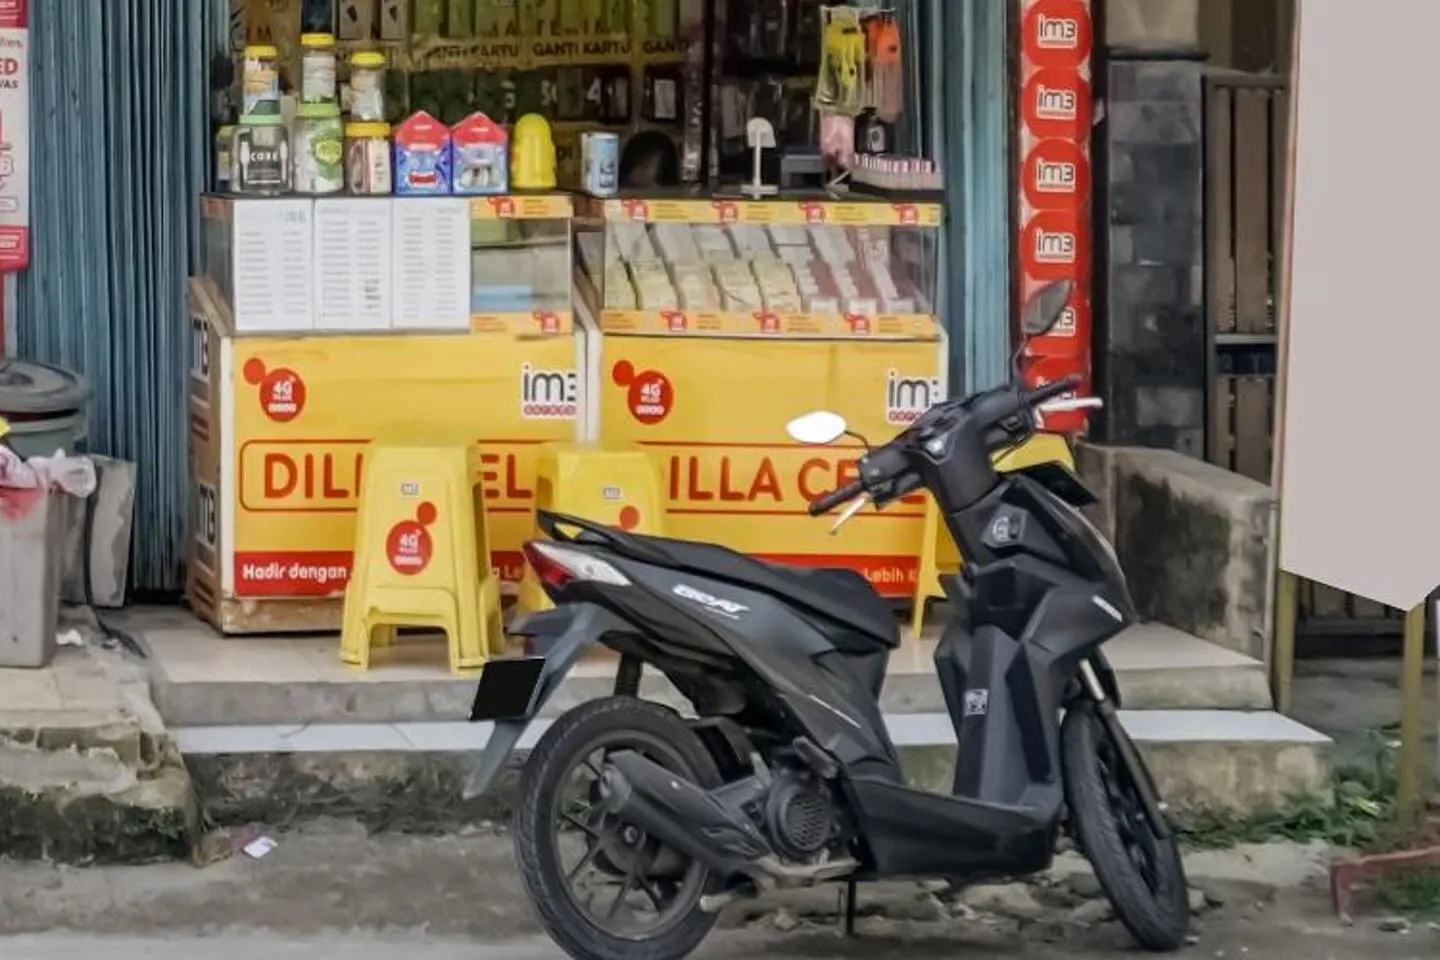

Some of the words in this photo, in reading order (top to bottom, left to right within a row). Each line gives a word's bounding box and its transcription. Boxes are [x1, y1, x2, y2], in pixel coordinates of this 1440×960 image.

[1039, 15, 1076, 39] im3
[1038, 87, 1075, 110] im3
[1037, 159, 1074, 183] im3
[1036, 230, 1074, 253] im3
[888, 370, 939, 409] im
[668, 455, 783, 503] ILLA
[242, 563, 285, 580] Hadir
[287, 563, 347, 585] dengan
[863, 567, 905, 583] Lebih
